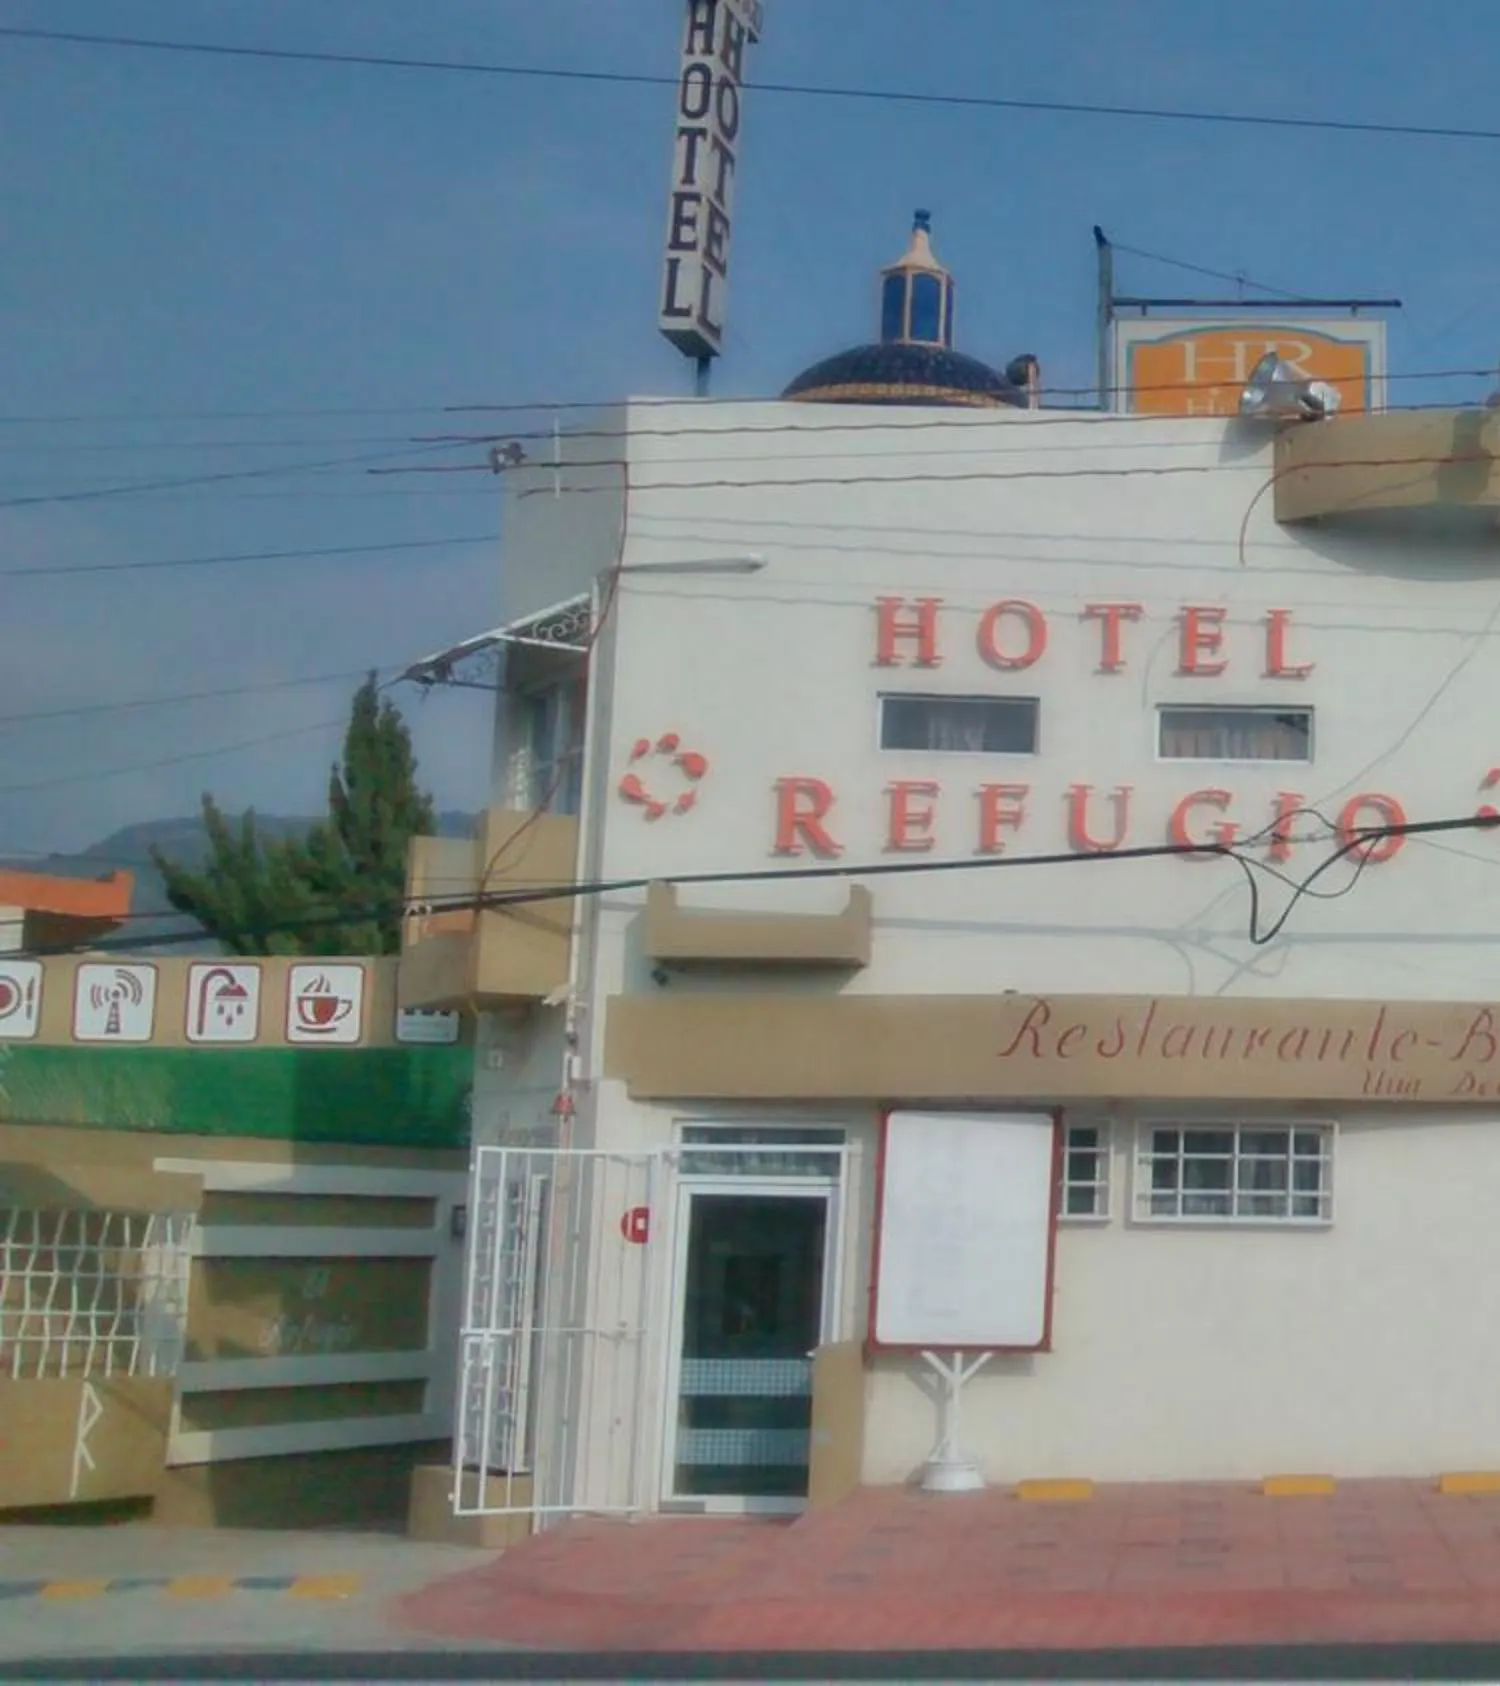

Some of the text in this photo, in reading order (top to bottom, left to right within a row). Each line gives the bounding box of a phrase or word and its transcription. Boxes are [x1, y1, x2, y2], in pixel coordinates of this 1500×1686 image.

[661, 0, 717, 318] HOTEL
[697, 2, 746, 342] HOTEL
[868, 595, 1317, 680] HOTEL
[768, 776, 1408, 864] REFUGIO
